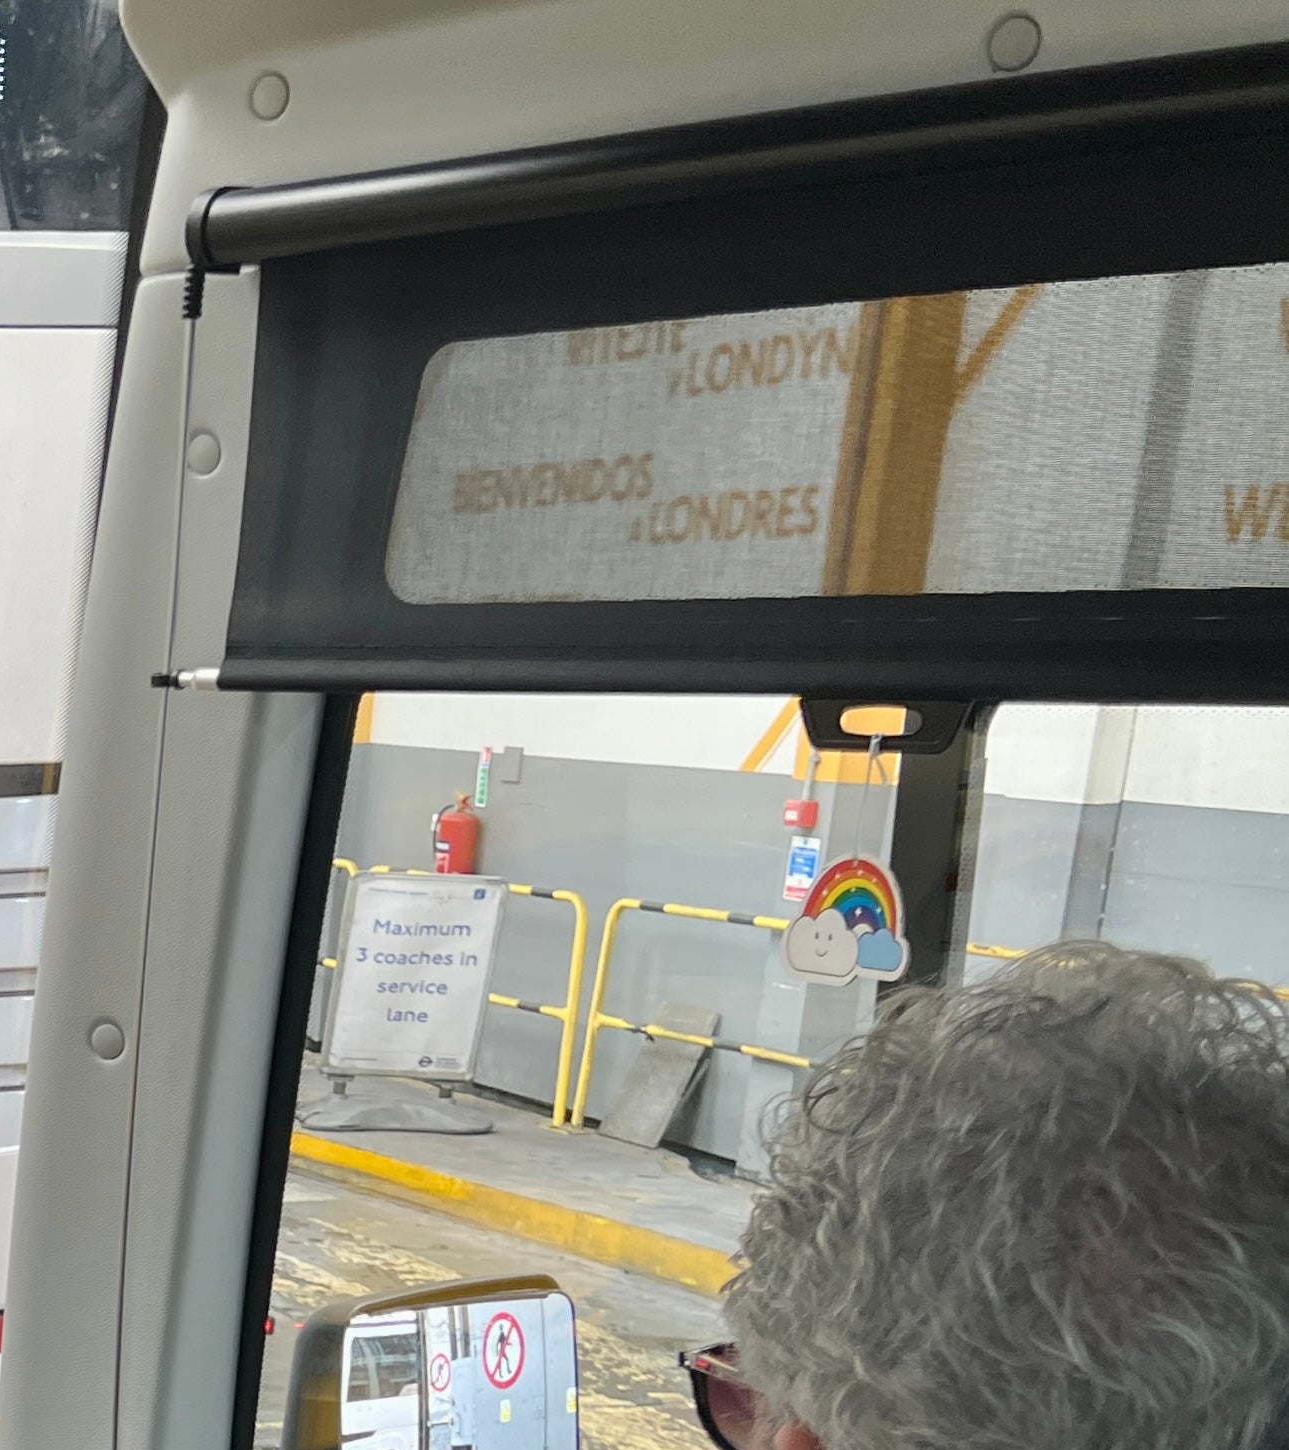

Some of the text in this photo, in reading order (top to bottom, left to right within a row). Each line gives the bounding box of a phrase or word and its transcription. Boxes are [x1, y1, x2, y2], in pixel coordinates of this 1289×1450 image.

[373, 918, 471, 937] Maximum
[356, 947, 478, 966] 3 coaches in
[377, 980, 448, 995] service
[386, 1007, 429, 1023] lane
